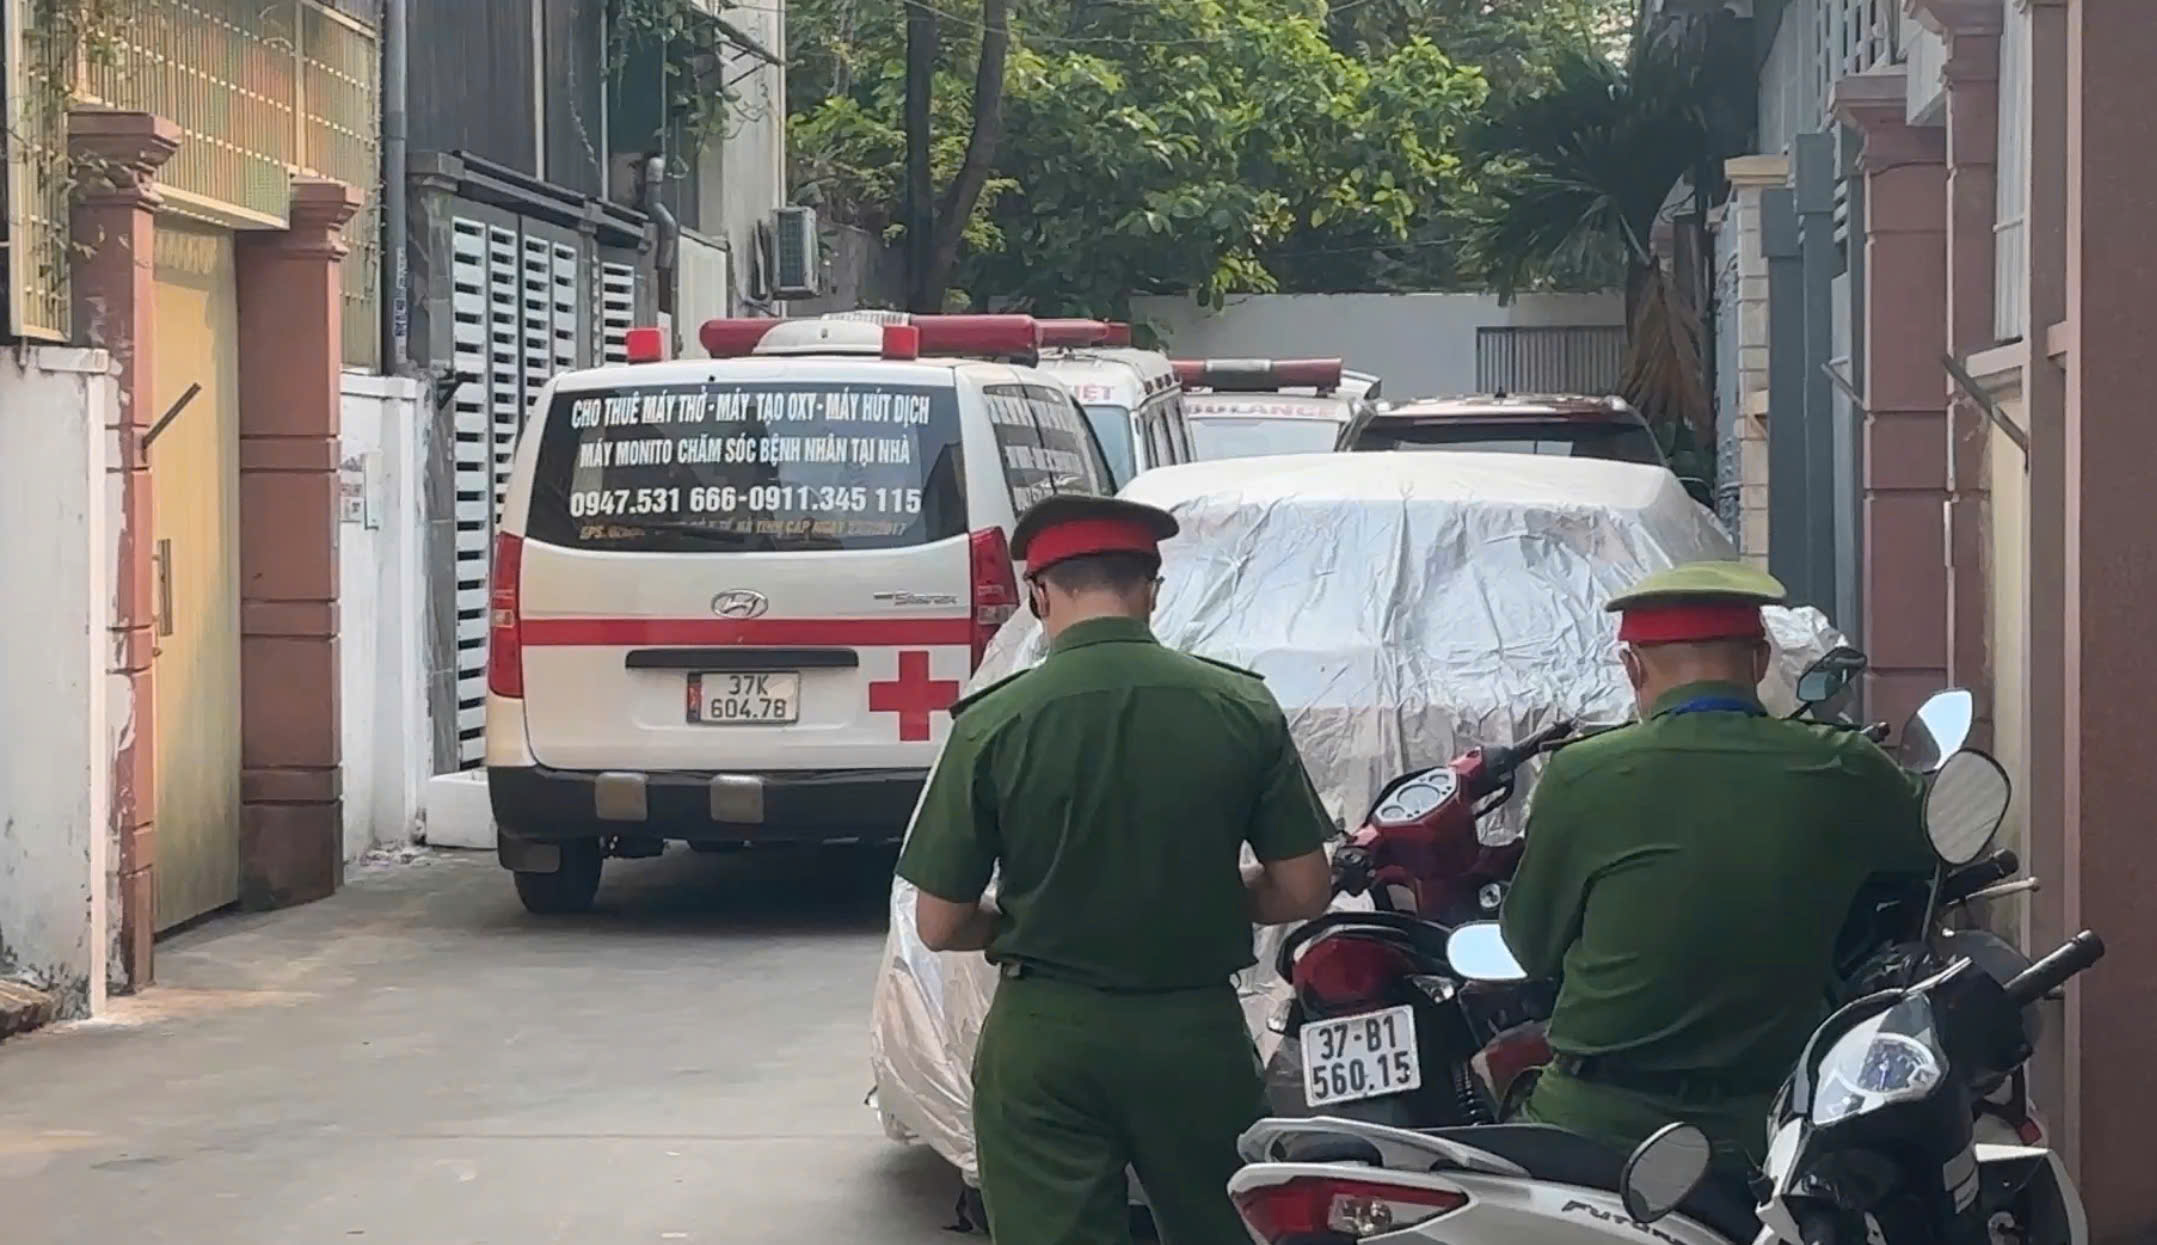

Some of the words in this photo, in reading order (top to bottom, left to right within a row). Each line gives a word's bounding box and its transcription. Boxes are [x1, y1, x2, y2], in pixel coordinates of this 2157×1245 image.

[571, 399, 600, 429] CHO
[604, 391, 640, 426] THUÊ
[642, 389, 677, 424] MÁY
[678, 386, 708, 423] THỞ
[716, 387, 750, 422] MÁY
[756, 392, 784, 425] TẠO
[788, 392, 817, 421] OXY
[825, 386, 859, 420] MÁY
[862, 387, 893, 421] HÚT
[894, 395, 930, 428] DỊCH
[579, 438, 614, 468] MÁY
[615, 438, 673, 466] MONITO
[677, 433, 722, 464] CHĂM
[725, 432, 757, 463] SÓC
[759, 433, 800, 467] BỆNH
[804, 433, 848, 463] NHÂN
[850, 437, 874, 468] TẠI
[878, 434, 910, 464] NHÀ
[569, 487, 680, 518] 0947.531
[690, 485, 866, 512] 666-0911.345
[876, 487, 921, 514] 115
[728, 675, 769, 696] 37K
[711, 698, 787, 719] 604.78
[1319, 1015, 1396, 1060] 37-B1
[1313, 1051, 1411, 1099] 560.15
